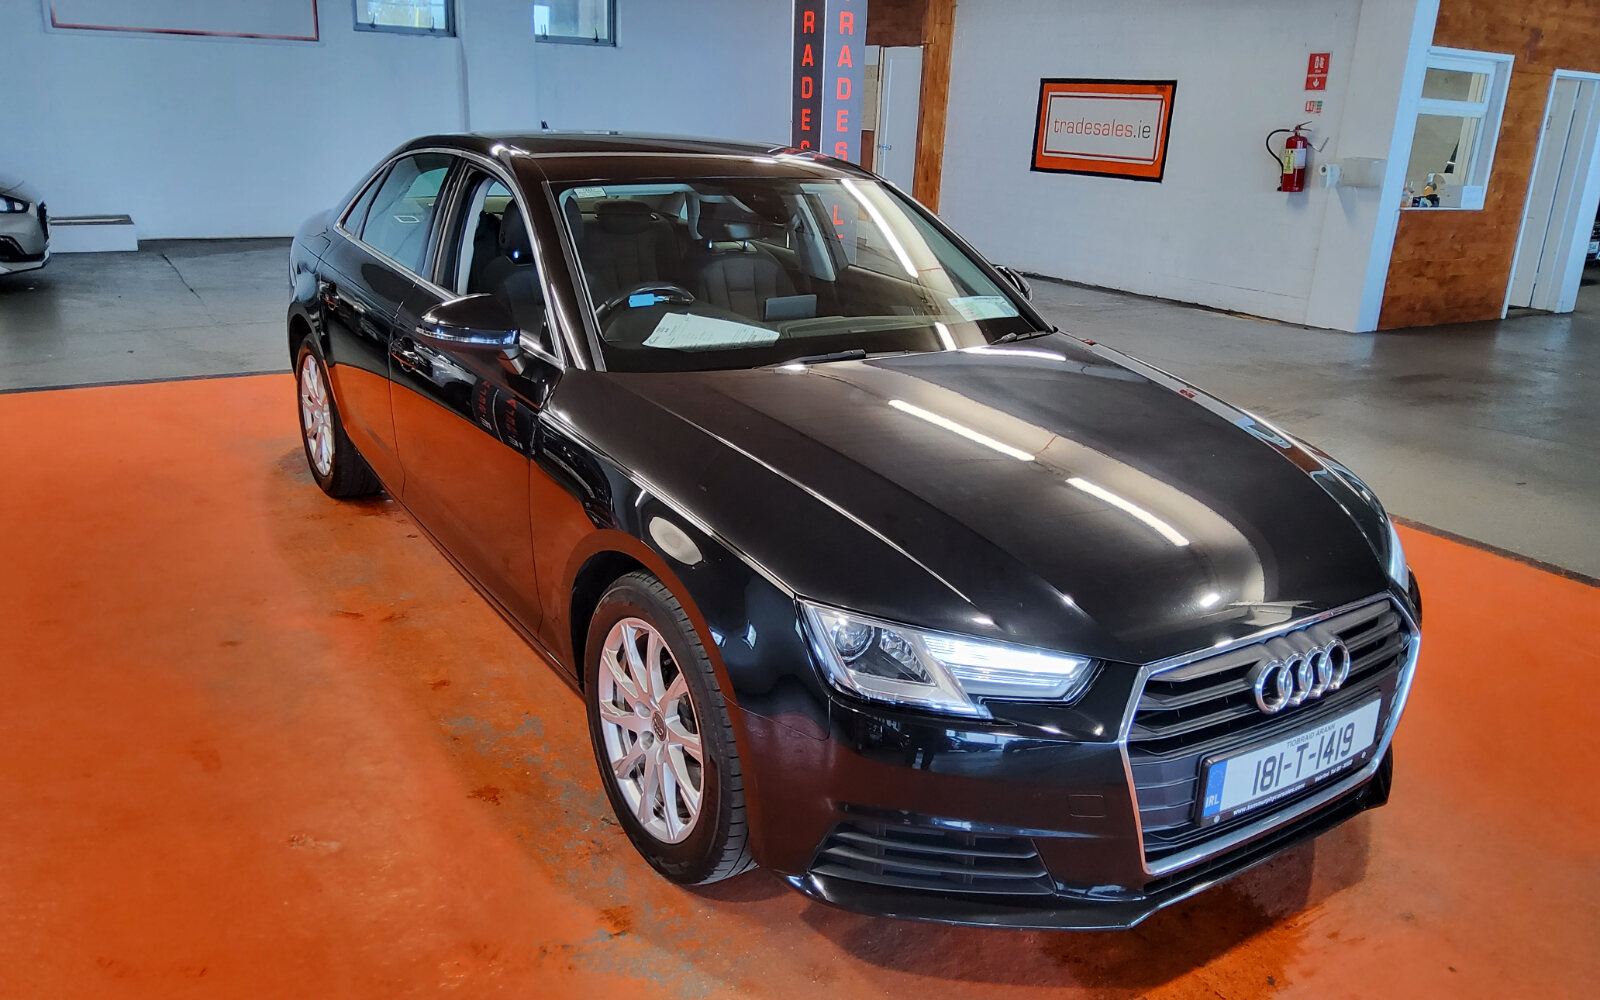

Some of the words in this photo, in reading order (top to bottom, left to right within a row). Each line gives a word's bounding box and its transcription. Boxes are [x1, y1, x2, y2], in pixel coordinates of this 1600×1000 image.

[1054, 117, 1151, 139] tradesales.ie
[1252, 722, 1355, 795] 181-T-1419
[1205, 794, 1220, 808] IRL
